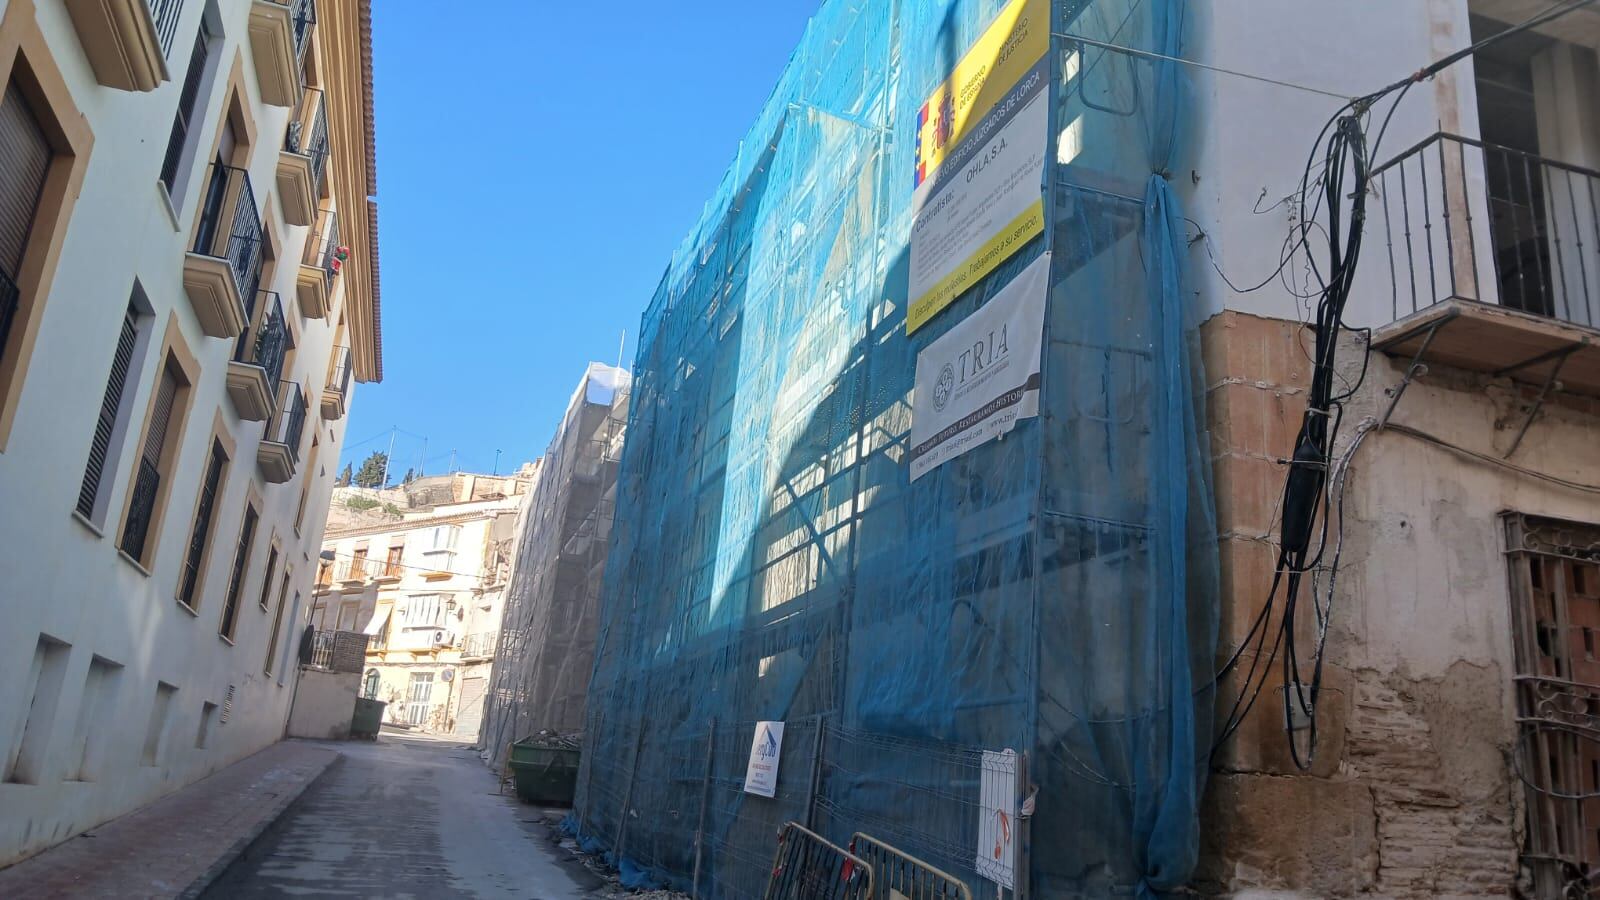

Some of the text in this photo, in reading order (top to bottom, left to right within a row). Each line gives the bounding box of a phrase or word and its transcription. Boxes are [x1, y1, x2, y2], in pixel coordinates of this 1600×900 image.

[1005, 31, 1028, 60] JUSTICIA
[950, 139, 973, 172] EDIFICIO
[973, 107, 1005, 148] JUZGADOS
[1006, 95, 1016, 113] DE
[1016, 71, 1040, 102] LORCA
[916, 190, 955, 233] Contratista:
[969, 245, 1000, 277] Trabajamos
[958, 322, 1008, 384] TRIA
